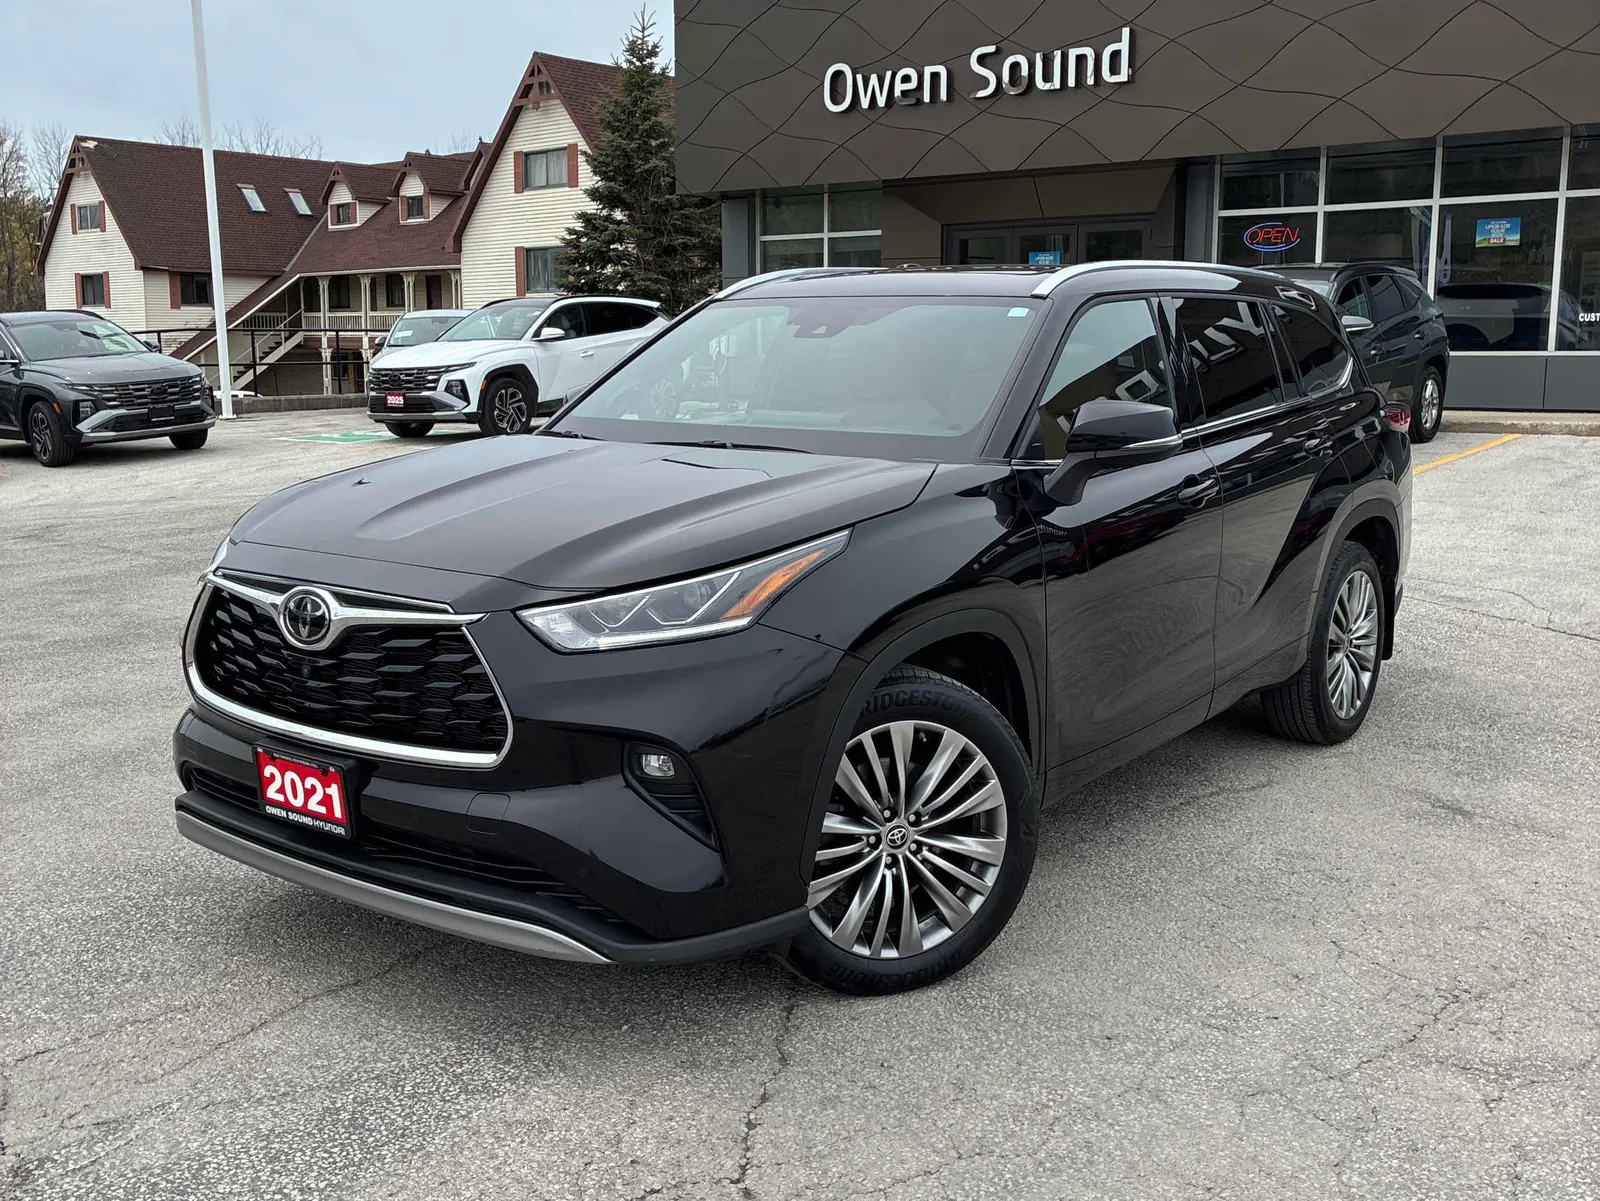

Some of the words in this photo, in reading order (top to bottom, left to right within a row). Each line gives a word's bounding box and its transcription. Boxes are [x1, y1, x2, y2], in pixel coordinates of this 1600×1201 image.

[823, 62, 948, 113] Owen
[968, 26, 1131, 98] Sound
[1247, 227, 1300, 243] OPEN
[263, 764, 342, 819] 2021
[265, 805, 287, 818] OWEN
[287, 811, 313, 826] SOUND
[313, 820, 346, 836] HYUNDAI
